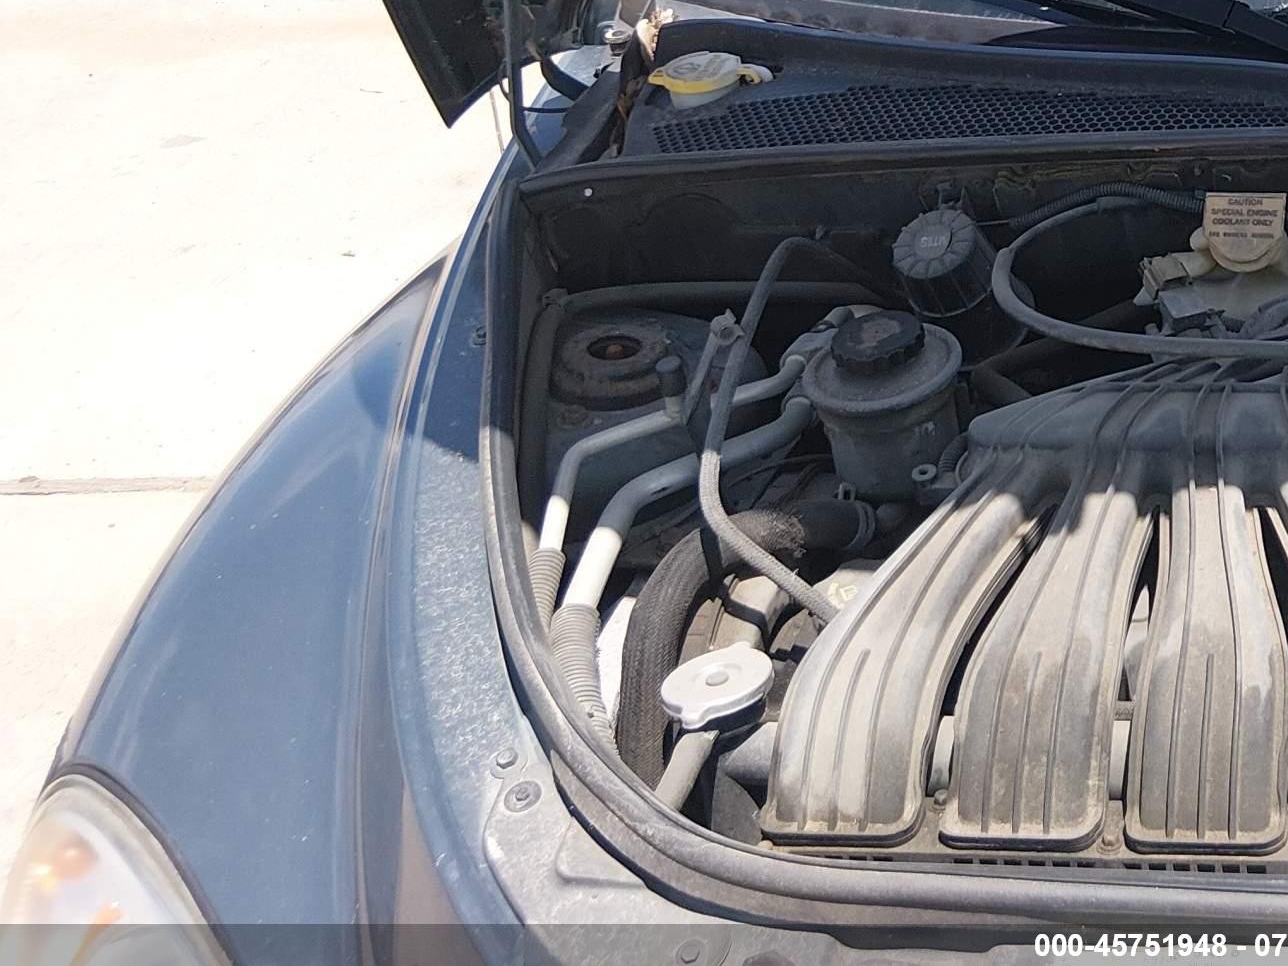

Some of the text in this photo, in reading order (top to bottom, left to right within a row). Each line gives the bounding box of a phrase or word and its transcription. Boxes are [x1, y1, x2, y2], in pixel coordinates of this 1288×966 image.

[1228, 198, 1263, 206] CAUTION
[1211, 208, 1279, 217] SPECIAL ENGINE
[1212, 218, 1274, 227] COOLANT ONLY
